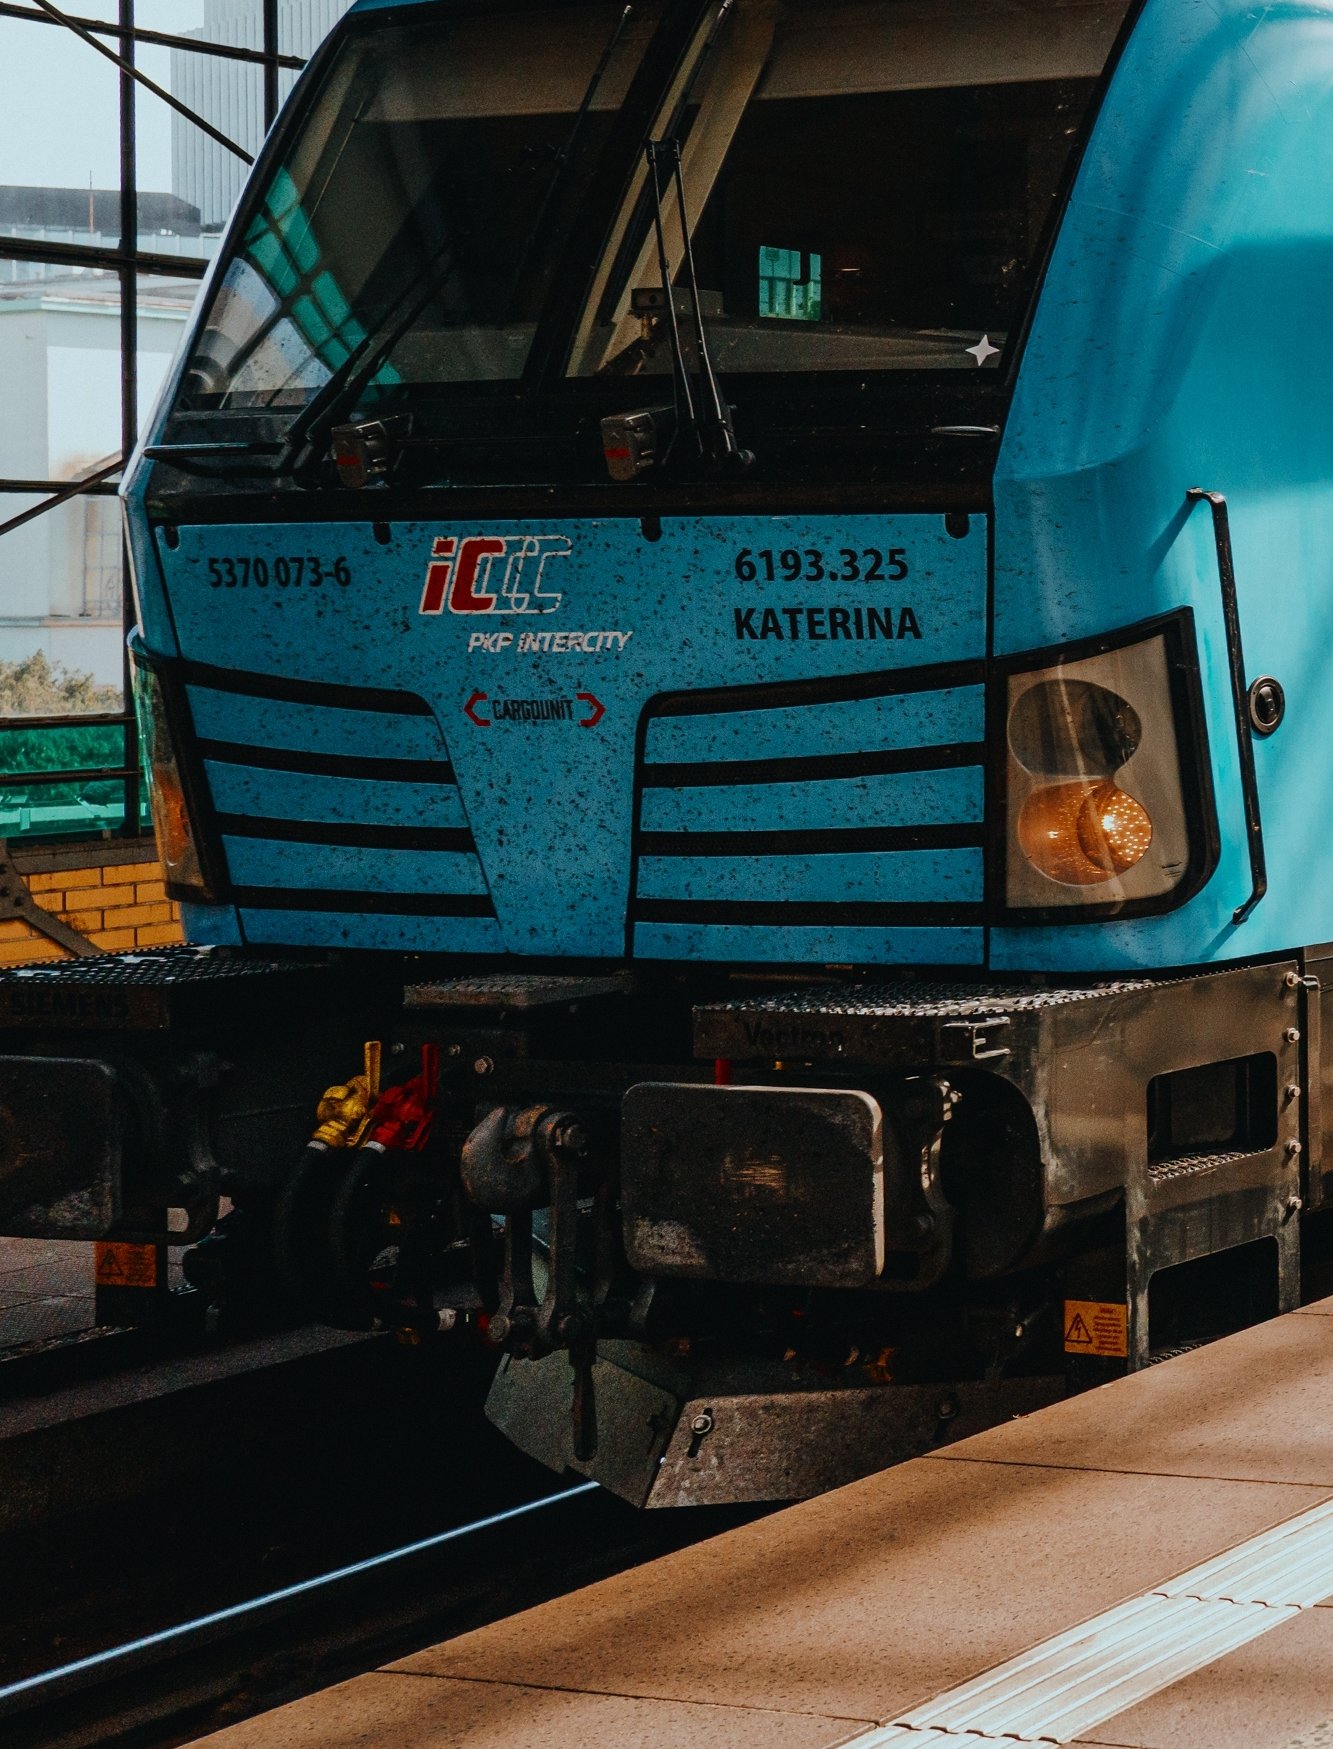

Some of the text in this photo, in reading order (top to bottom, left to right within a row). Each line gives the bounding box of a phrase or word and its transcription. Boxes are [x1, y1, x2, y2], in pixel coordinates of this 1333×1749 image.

[208, 556, 353, 588] 5370 073-6
[734, 547, 909, 582] 6193.325
[733, 606, 923, 640] KATERINA
[467, 630, 634, 653] PKP INTERCITY
[491, 699, 574, 722] CARGOUNIT
